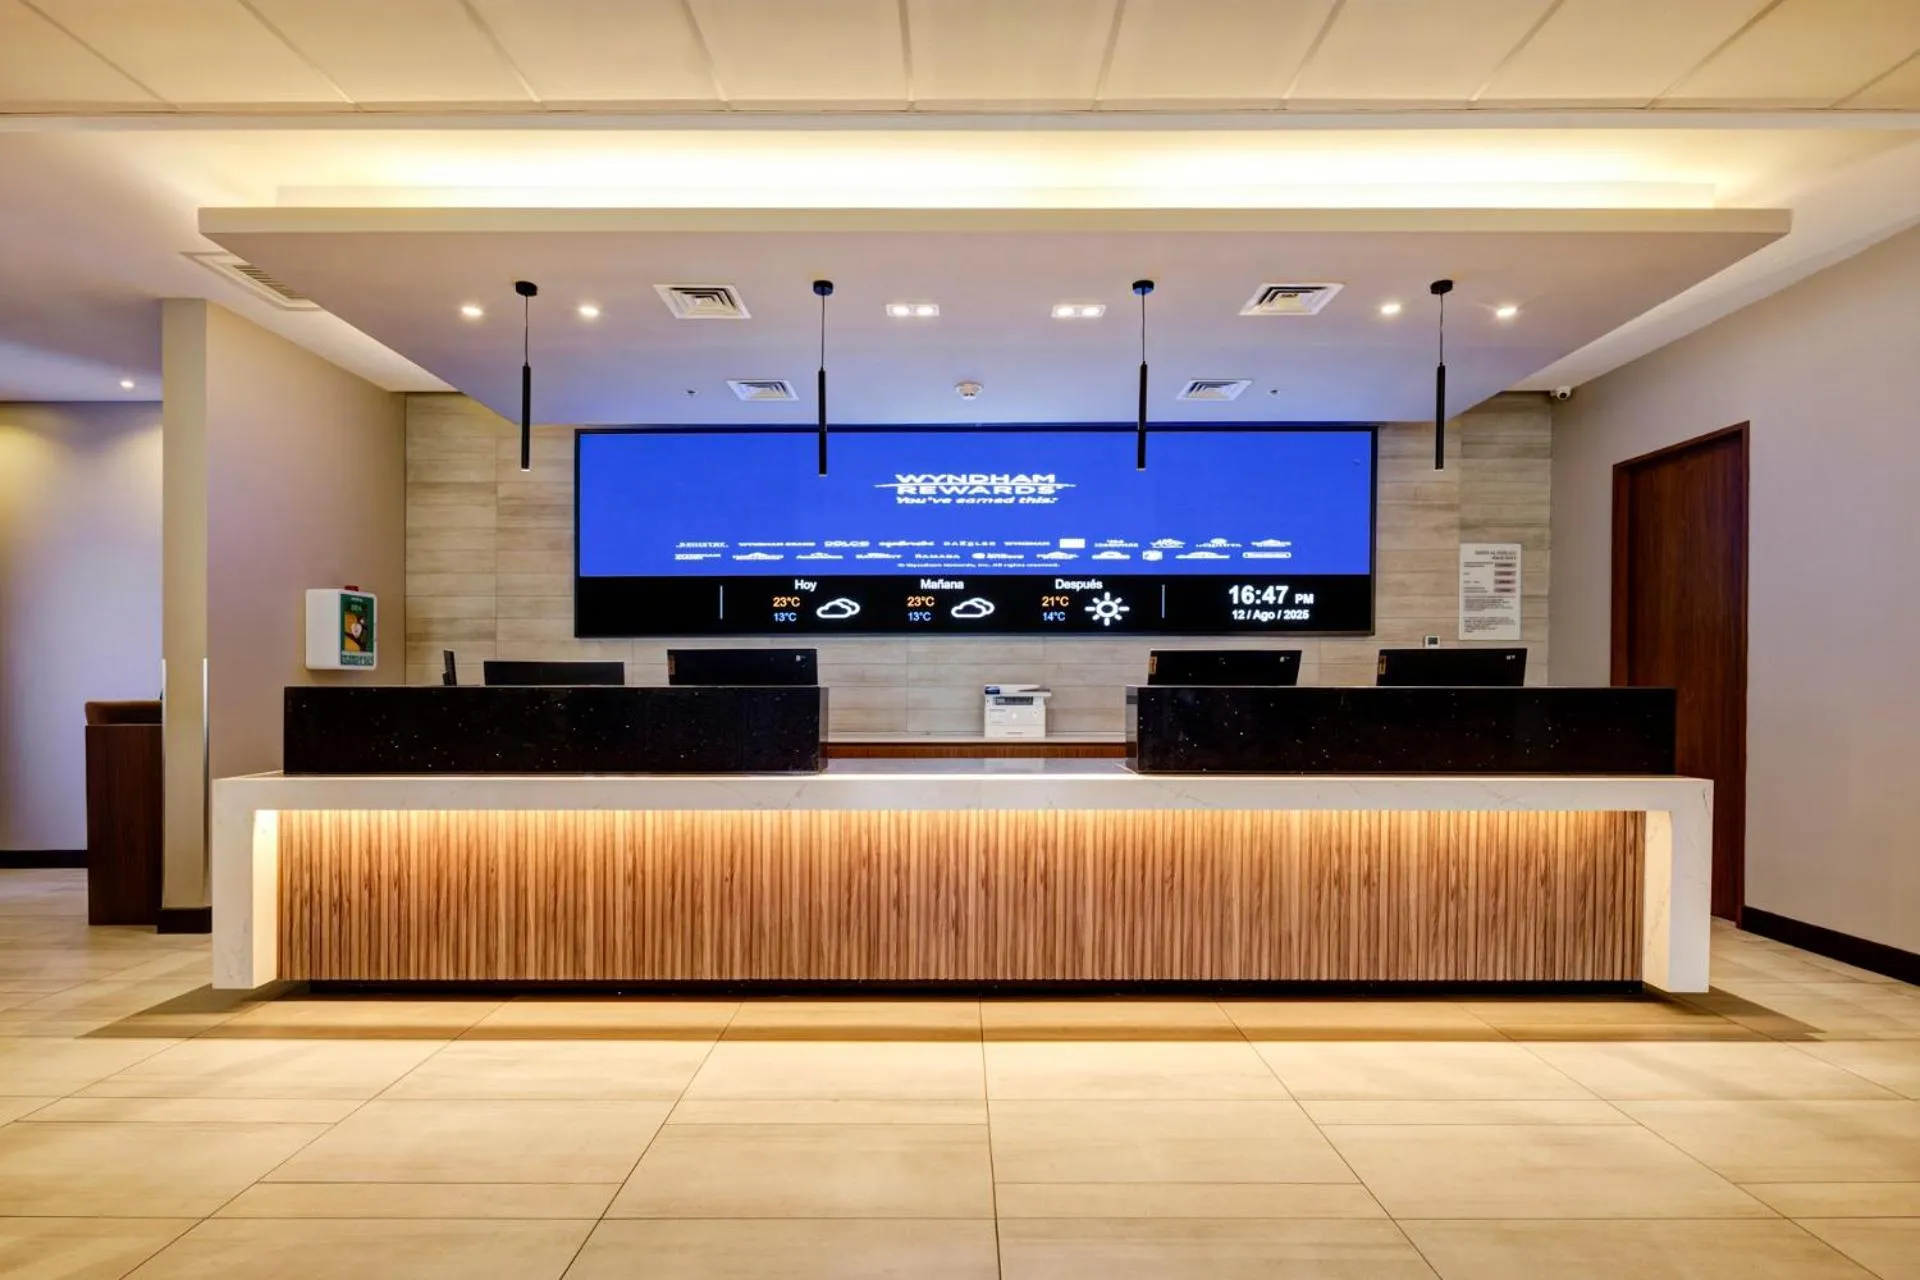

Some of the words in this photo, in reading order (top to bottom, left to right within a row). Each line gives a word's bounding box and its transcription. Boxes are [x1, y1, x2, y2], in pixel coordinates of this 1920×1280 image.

[895, 473, 1056, 484] WYNDHAM
[896, 485, 1056, 495] REWARDS
[896, 496, 953, 504] You've
[955, 496, 1016, 504] earned
[794, 579, 818, 592] Hoy
[920, 578, 965, 590] Mañana
[1054, 578, 1104, 592] Después
[1228, 584, 1289, 605] 16:47
[1294, 593, 1315, 605] PM
[772, 596, 801, 608] 23°C
[906, 596, 935, 608] 23°C
[1041, 595, 1070, 607] 21°C
[773, 611, 797, 622] 13°C
[907, 611, 932, 622] 13°C
[1042, 611, 1066, 622] 14°C
[1231, 609, 1246, 620] 12
[1252, 609, 1276, 622] Ago
[1283, 609, 1310, 620] 2025
